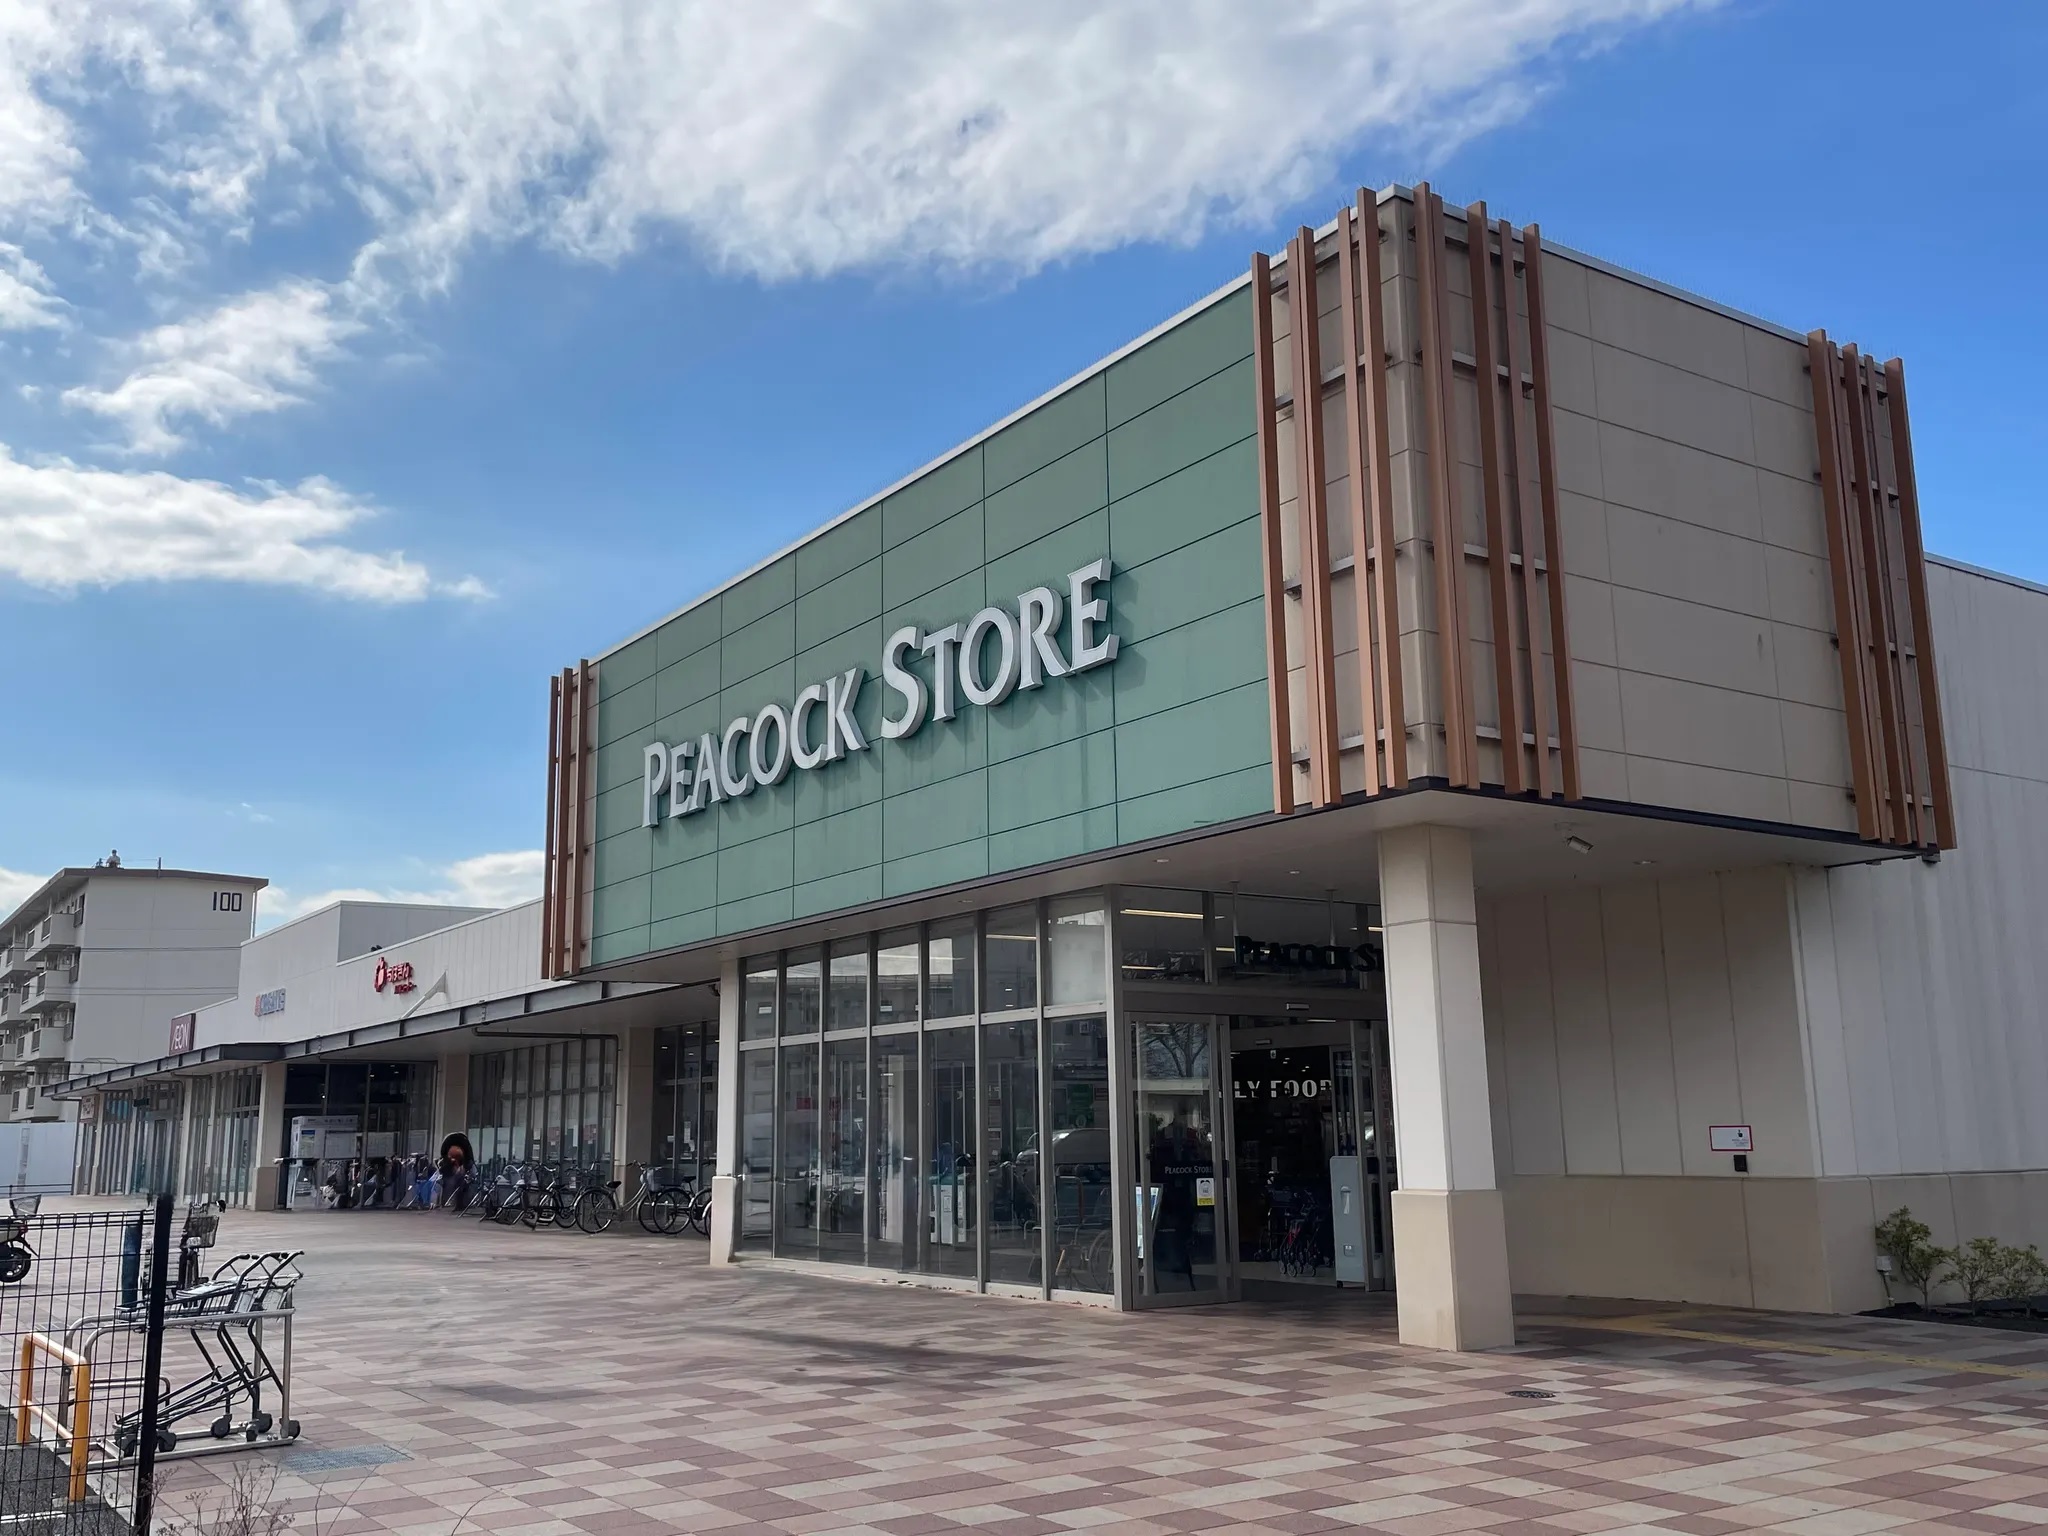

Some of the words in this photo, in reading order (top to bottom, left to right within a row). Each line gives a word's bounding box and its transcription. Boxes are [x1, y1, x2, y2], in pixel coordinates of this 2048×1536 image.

[641, 667, 871, 829] PEACOCK
[880, 556, 1121, 740] STORE
[213, 891, 242, 912] 100
[1234, 936, 1353, 970] PEACOCK
